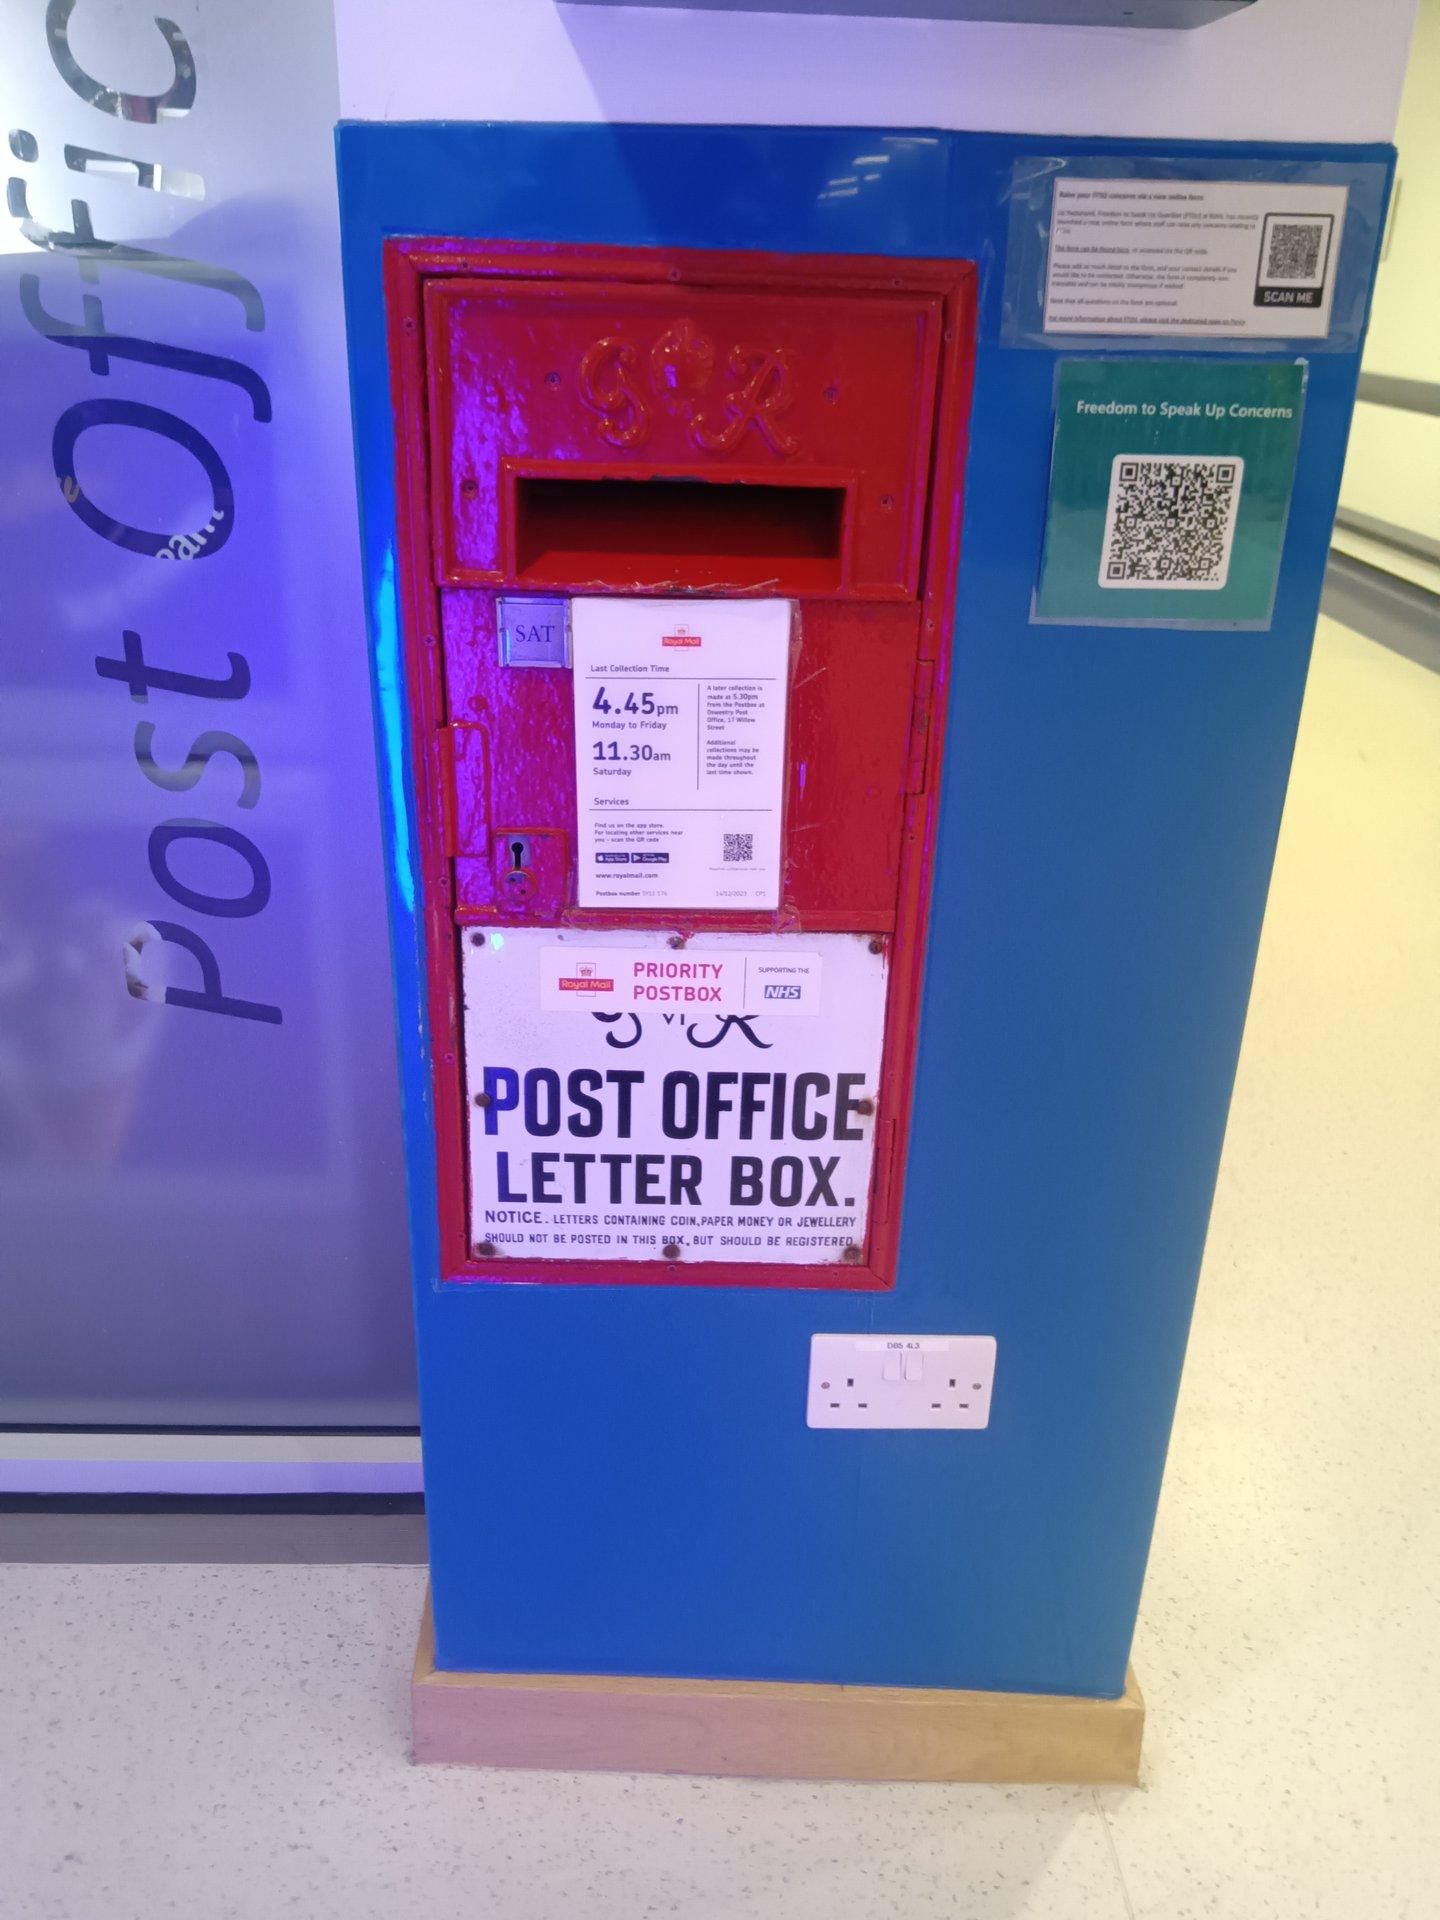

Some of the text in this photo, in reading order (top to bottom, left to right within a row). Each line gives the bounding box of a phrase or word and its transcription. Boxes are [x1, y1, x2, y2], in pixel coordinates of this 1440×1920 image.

[1264, 291, 1314, 303] SCAN ME
[1077, 400, 1293, 420] Freedom to Speak Up Concerns
[515, 625, 555, 644] SAT
[590, 664, 670, 673] Last Collection Time
[592, 686, 679, 717] 4.45pm
[592, 721, 626, 731] Monday
[640, 721, 667, 731] Friday
[592, 741, 672, 761] 11.30am
[593, 767, 632, 778] Saturday
[594, 797, 629, 806] Services
[95, 630, 283, 1026] Post
[595, 872, 658, 880] www.royalmail.com
[633, 963, 724, 979] PRIORITY
[561, 980, 611, 991] Royal Mail
[633, 985, 722, 1001] POSTBOX
[767, 987, 799, 998] NHS
[483, 1066, 867, 1141] POST OFFICE
[497, 1151, 855, 1207] LETTER BOX.
[485, 1210, 549, 1224] NOTICE.
[553, 1214, 598, 1225] LETTERS
[604, 1215, 666, 1226] CONTAINING
[738, 1216, 773, 1227] MONEY
[778, 1217, 792, 1227] OR
[797, 1216, 857, 1227] JEWELLERY
[485, 1233, 524, 1243] SHOULD
[529, 1234, 548, 1243] NOT
[554, 1235, 565, 1244] BE
[571, 1234, 611, 1244] POSTED
[617, 1235, 628, 1244] IN
[630, 1235, 656, 1245] THIS
[694, 1236, 714, 1245] BUT
[720, 1236, 761, 1246] SHOULD
[768, 1237, 780, 1246] BE
